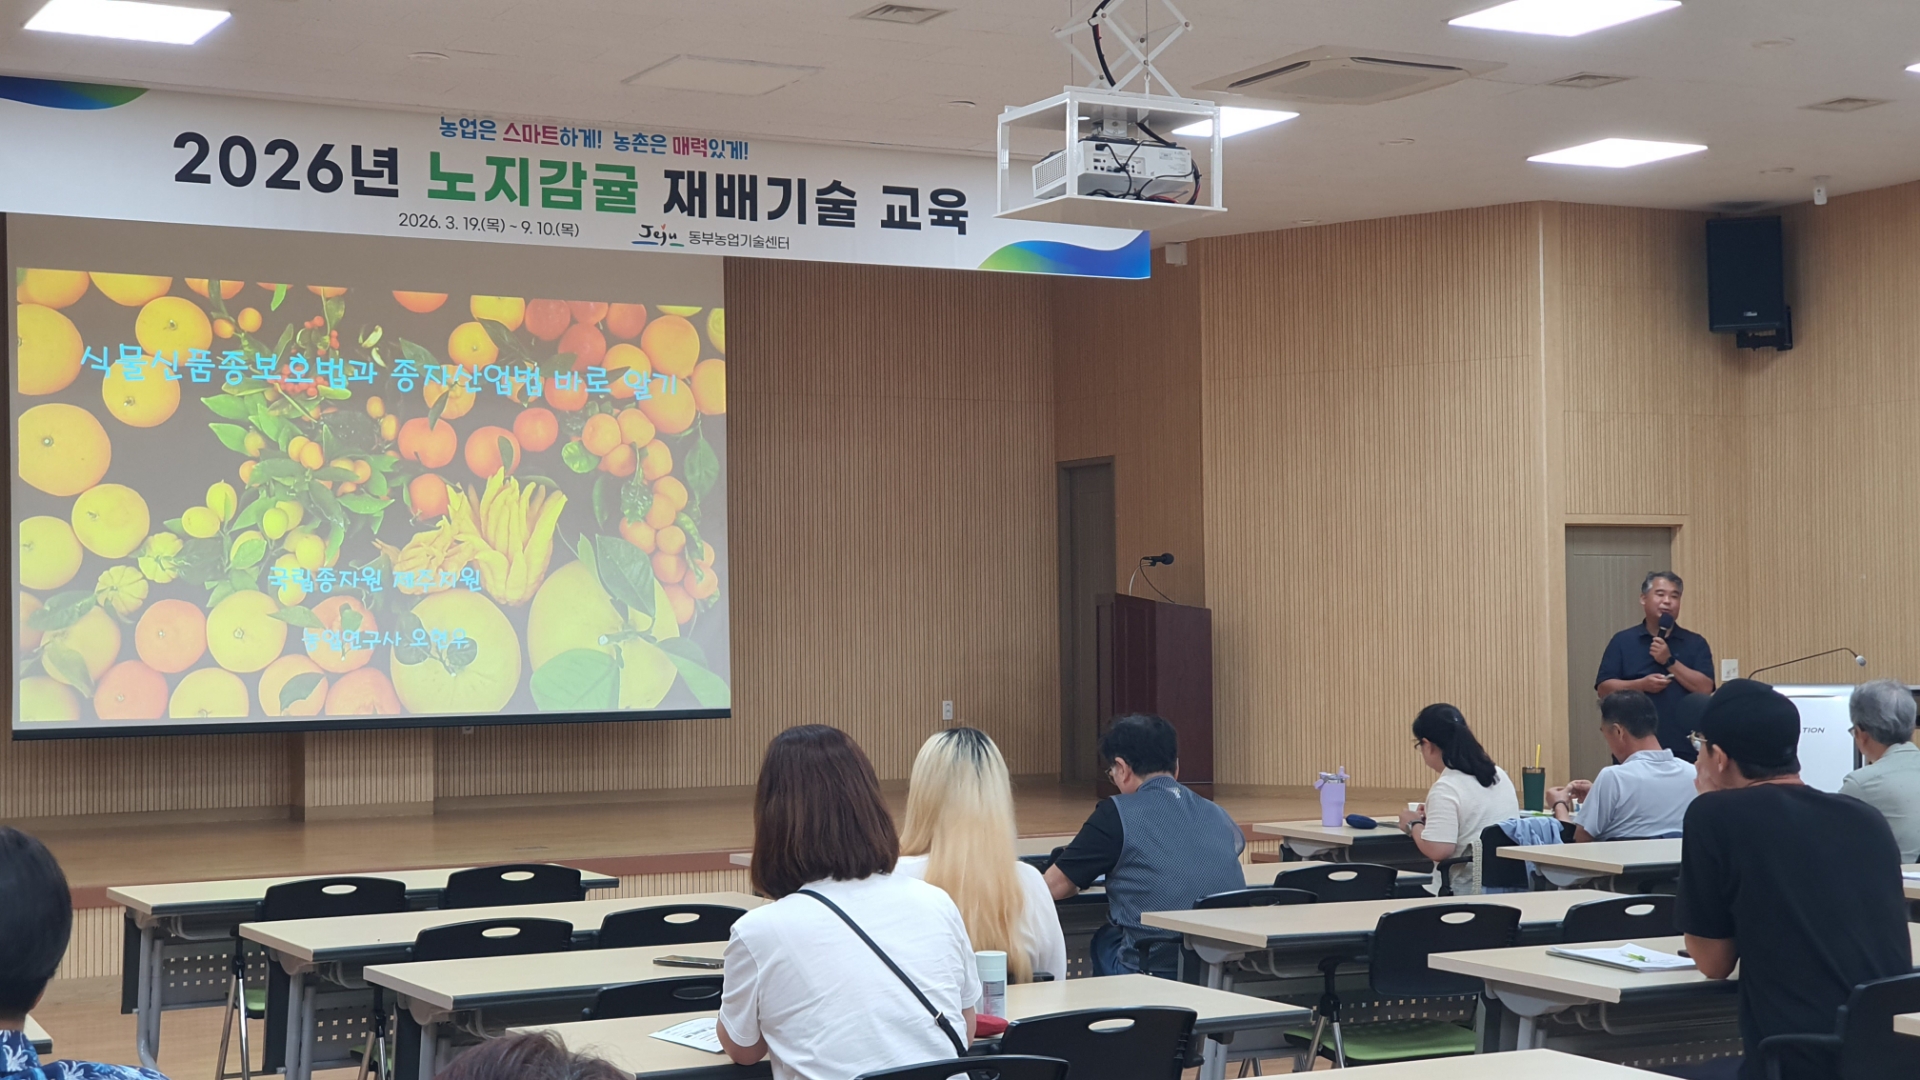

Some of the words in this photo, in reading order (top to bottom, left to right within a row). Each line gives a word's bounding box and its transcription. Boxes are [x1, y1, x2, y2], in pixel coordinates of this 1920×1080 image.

[439, 116, 497, 141] 농업은
[502, 123, 602, 150] 스마트하게!
[612, 130, 668, 155] 농촌은
[673, 135, 749, 161] 매력있게!
[173, 131, 399, 198] 2026년
[427, 150, 639, 215] 노지감귤
[663, 168, 857, 229] 재배기술
[881, 184, 969, 236] 교육
[398, 212, 442, 229] 2026.
[445, 215, 458, 231] 3.
[463, 215, 505, 232] 19.(목)
[521, 220, 534, 235] 9.
[537, 221, 580, 237] 10.(목)
[688, 230, 790, 251] 동부농업기술센터
[80, 343, 377, 389] 식물신품종보호법과
[390, 358, 543, 398] 종자산업법
[554, 365, 612, 394] 바로
[623, 368, 678, 401] 알기
[268, 566, 383, 593] 국립종자원
[302, 629, 402, 651] 농업연구사
